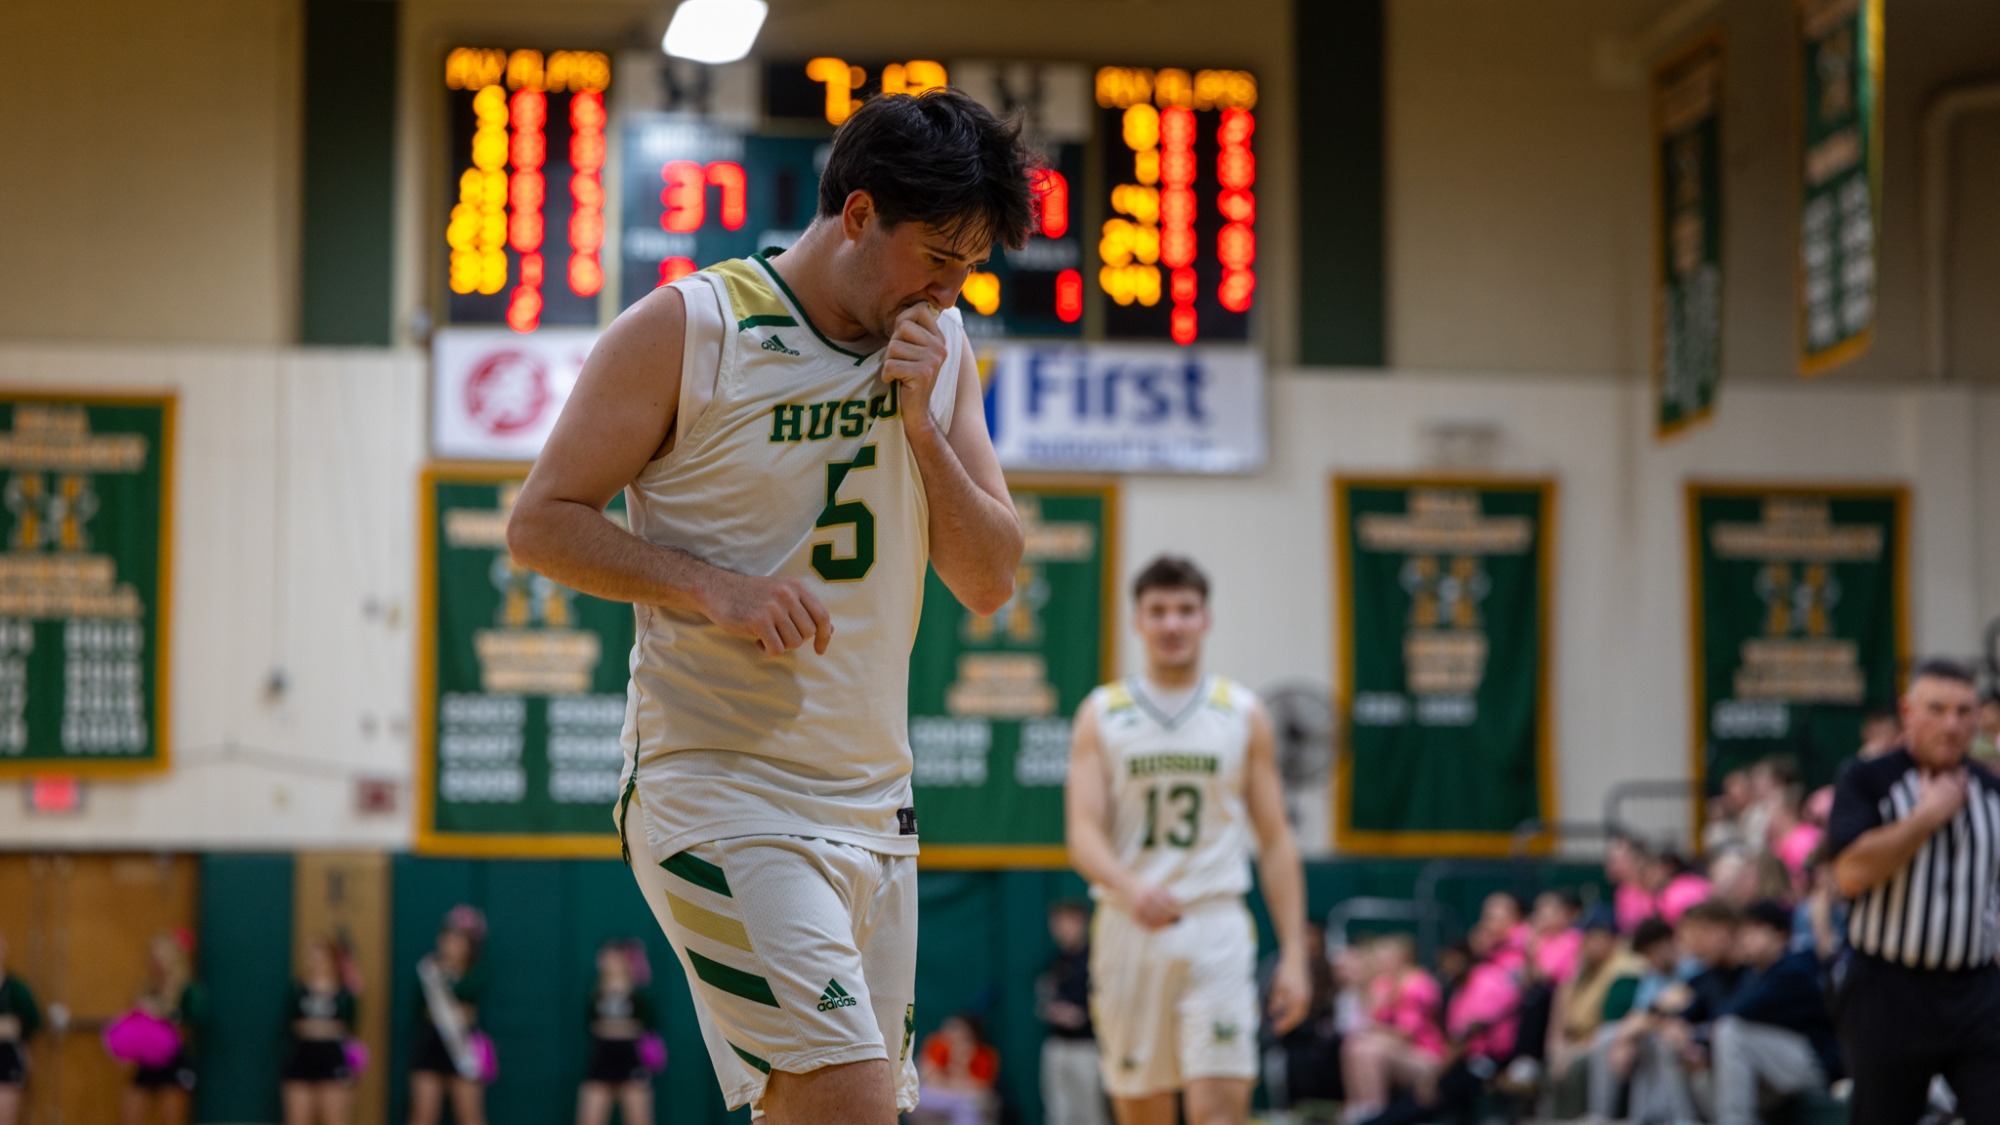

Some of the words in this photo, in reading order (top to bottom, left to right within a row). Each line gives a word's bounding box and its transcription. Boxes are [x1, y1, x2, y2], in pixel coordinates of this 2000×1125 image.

[660, 160, 747, 233] 37
[1026, 347, 1209, 425] First
[809, 441, 878, 584] 5
[1141, 785, 1202, 849] 13
[817, 996, 857, 1012] adidas
